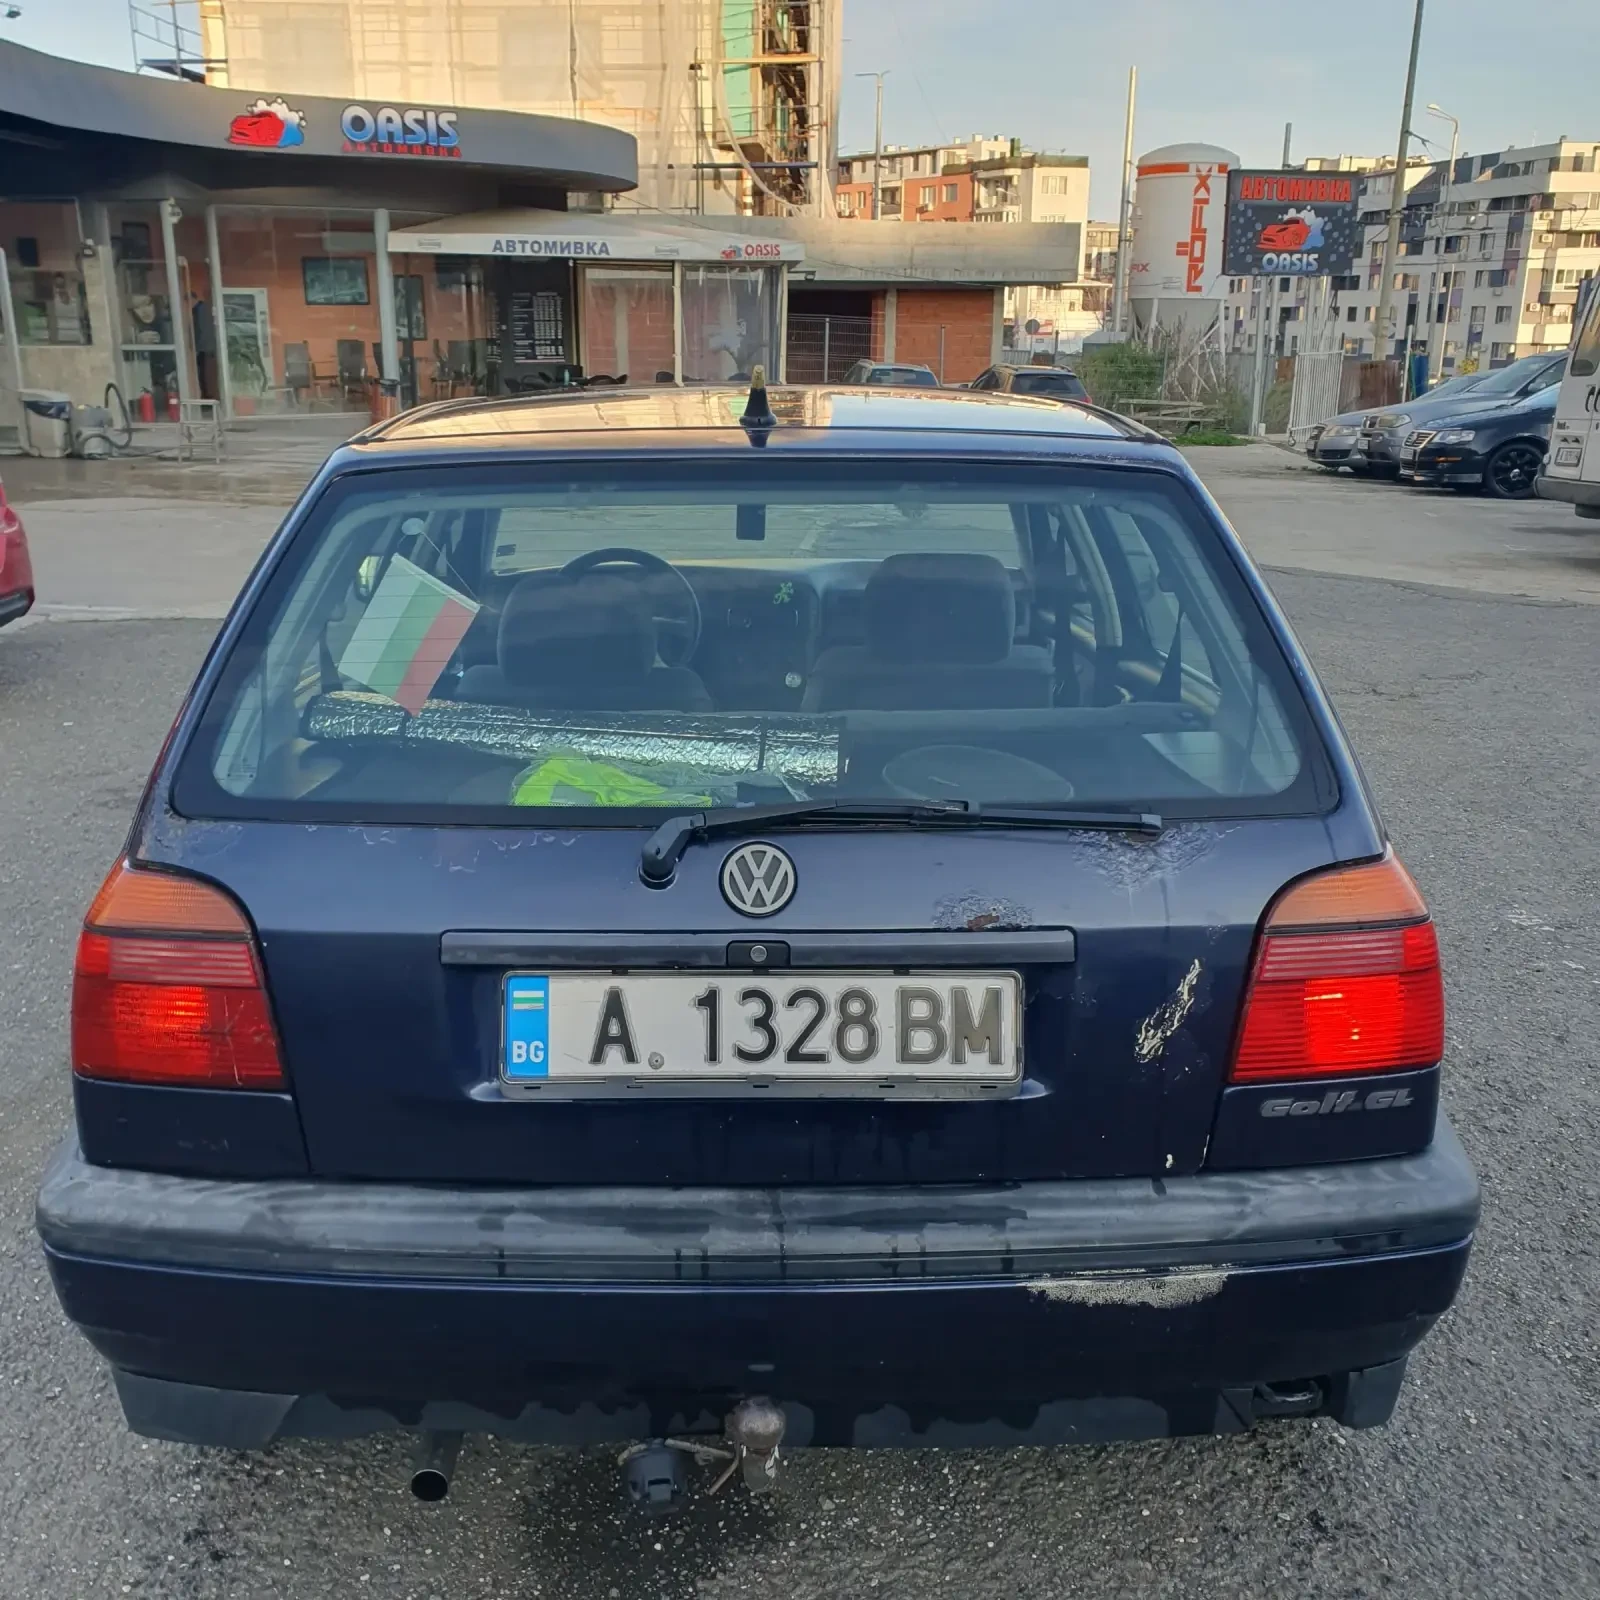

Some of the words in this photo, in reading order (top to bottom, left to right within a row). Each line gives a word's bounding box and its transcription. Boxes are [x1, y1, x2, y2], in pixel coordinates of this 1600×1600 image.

[341, 104, 460, 148] OASIS
[1240, 176, 1353, 203] АВТОМИВКА
[492, 239, 611, 256] АВТОМИВКА
[744, 243, 781, 257] OASIS
[1261, 252, 1319, 273] OASIS
[589, 985, 642, 1066] A
[690, 983, 883, 1066] 1328
[895, 984, 1005, 1066] BM
[511, 1039, 546, 1064] BG
